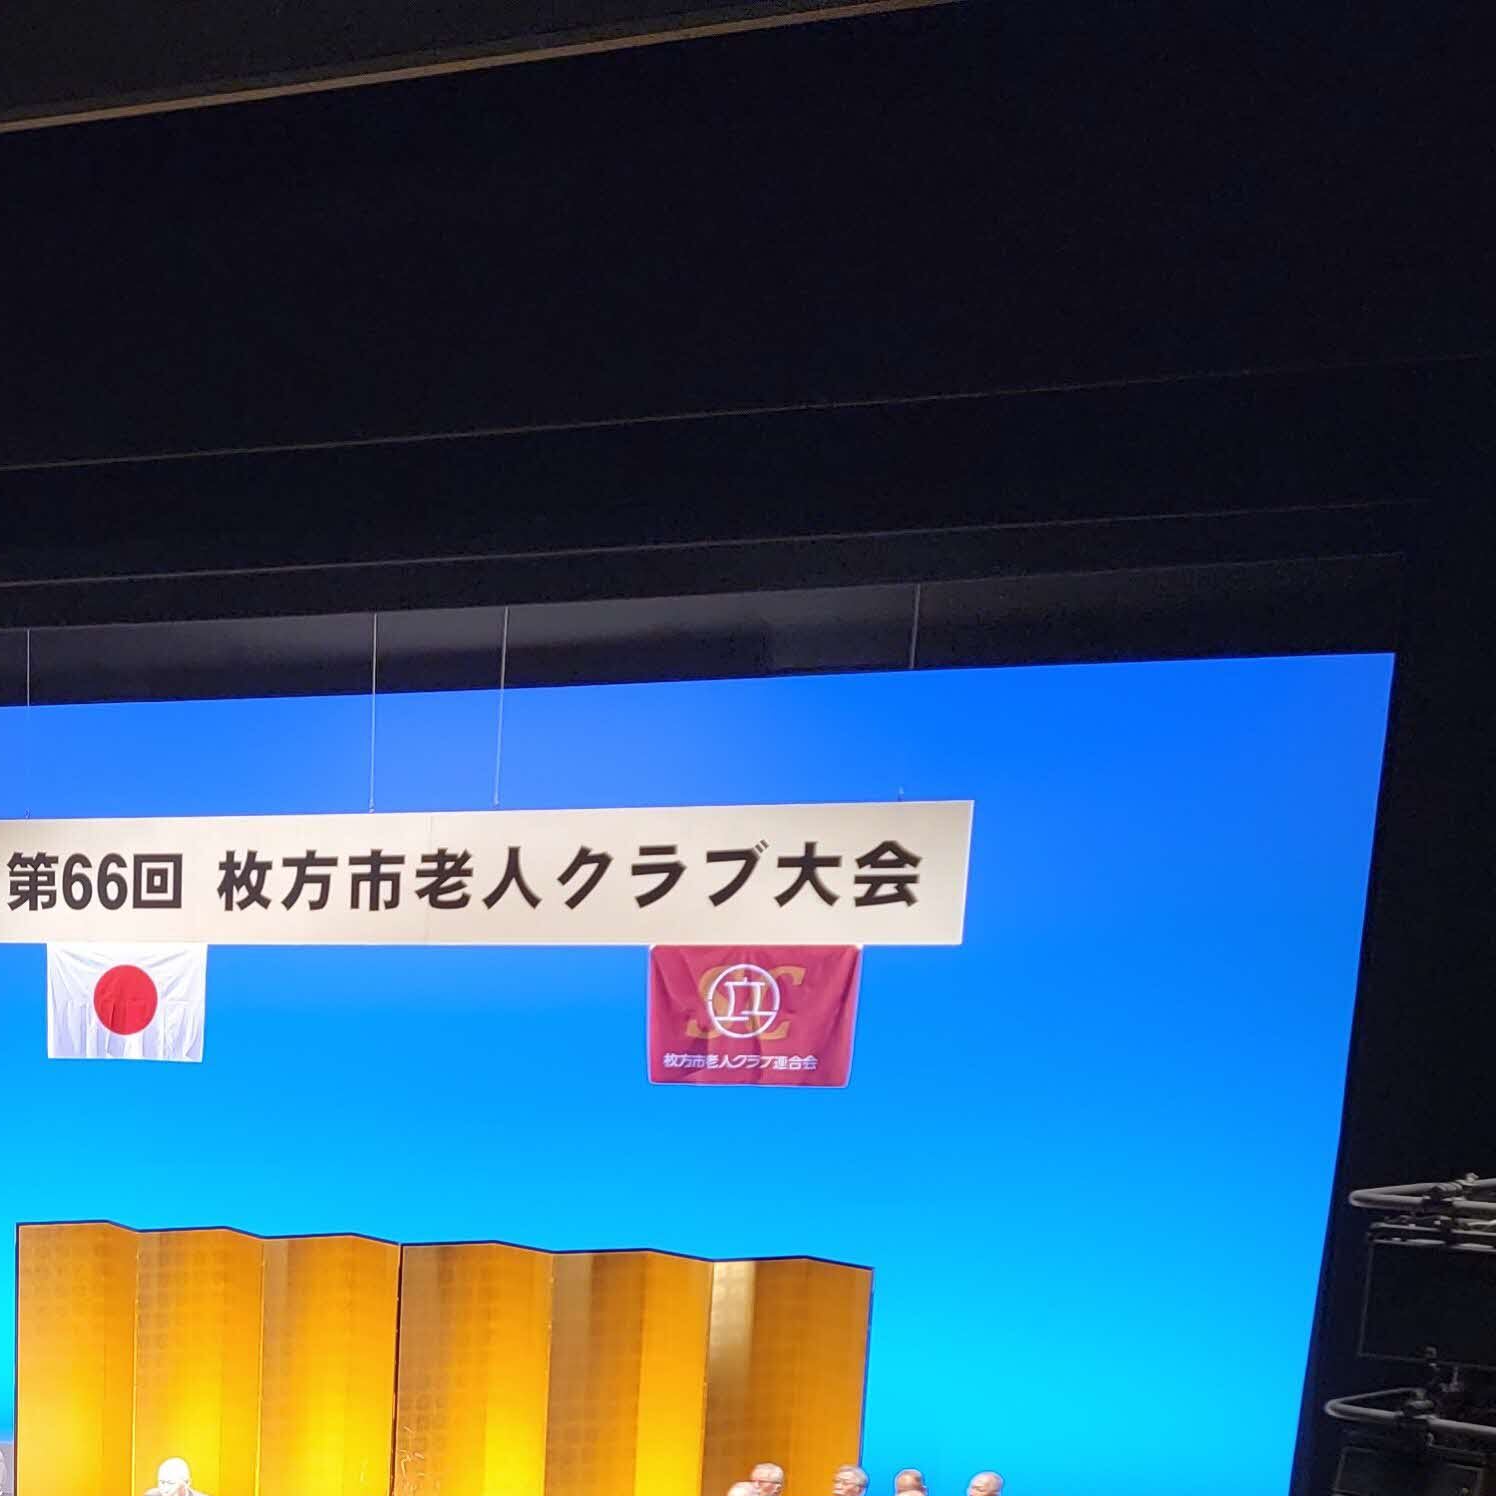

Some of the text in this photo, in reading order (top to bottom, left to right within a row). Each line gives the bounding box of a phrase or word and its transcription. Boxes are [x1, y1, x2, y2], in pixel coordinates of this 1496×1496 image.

[6, 840, 921, 911] 第66回 枚方市老人クラブ大会
[663, 1053, 817, 1071] 枚方市老人クラブ連合会
